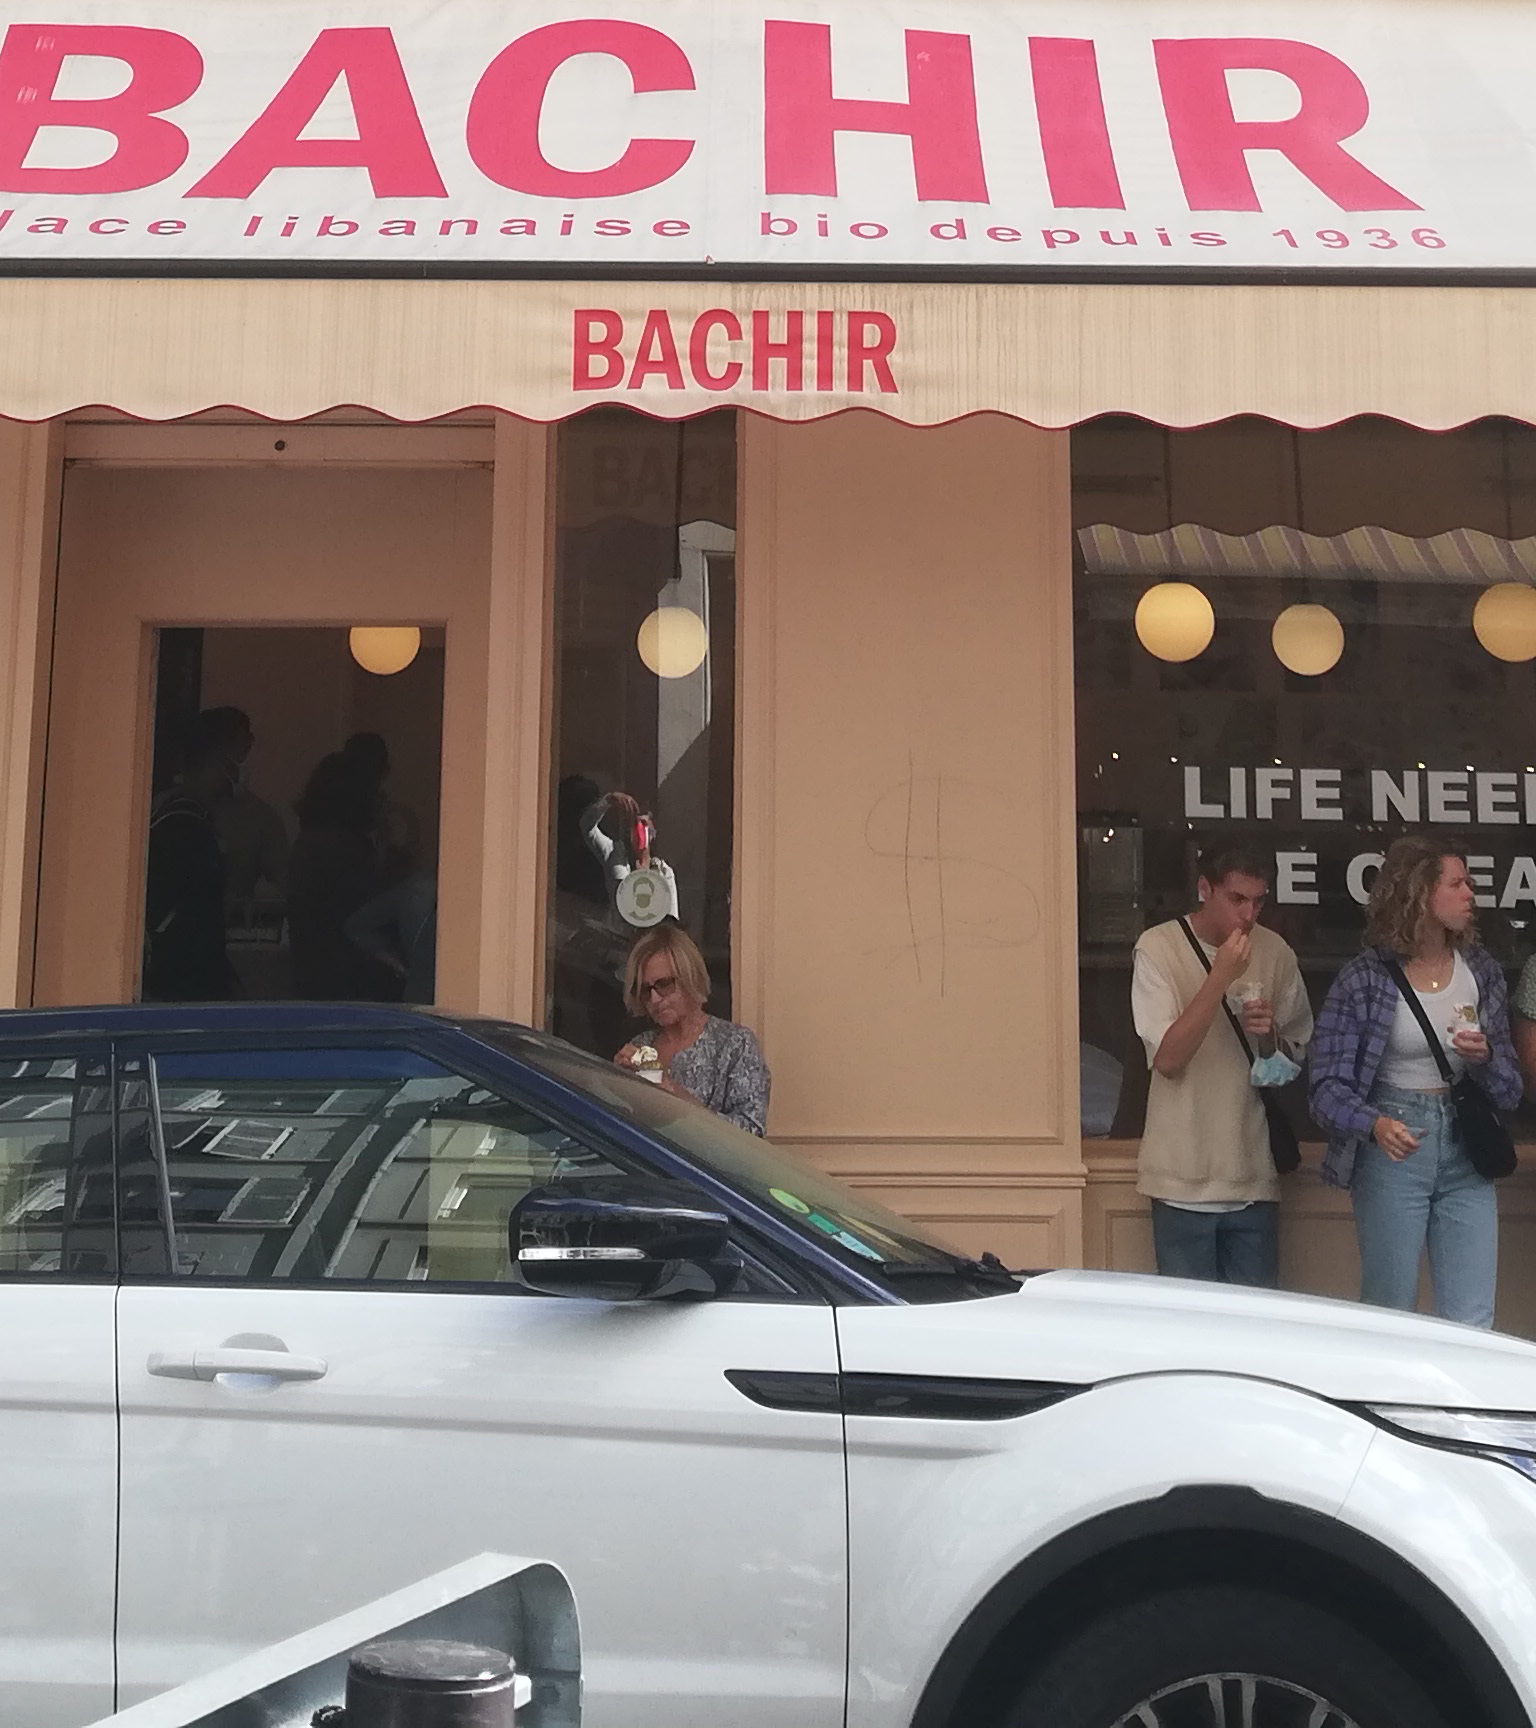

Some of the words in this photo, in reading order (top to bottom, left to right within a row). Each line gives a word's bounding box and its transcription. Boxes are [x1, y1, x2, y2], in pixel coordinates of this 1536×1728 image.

[244, 213, 692, 242] libanaise
[757, 211, 891, 242] bio
[928, 218, 1230, 252] depuis
[1272, 226, 1448, 252] 1936
[572, 308, 899, 395] BACHIR
[1183, 766, 1343, 822] LIFE
